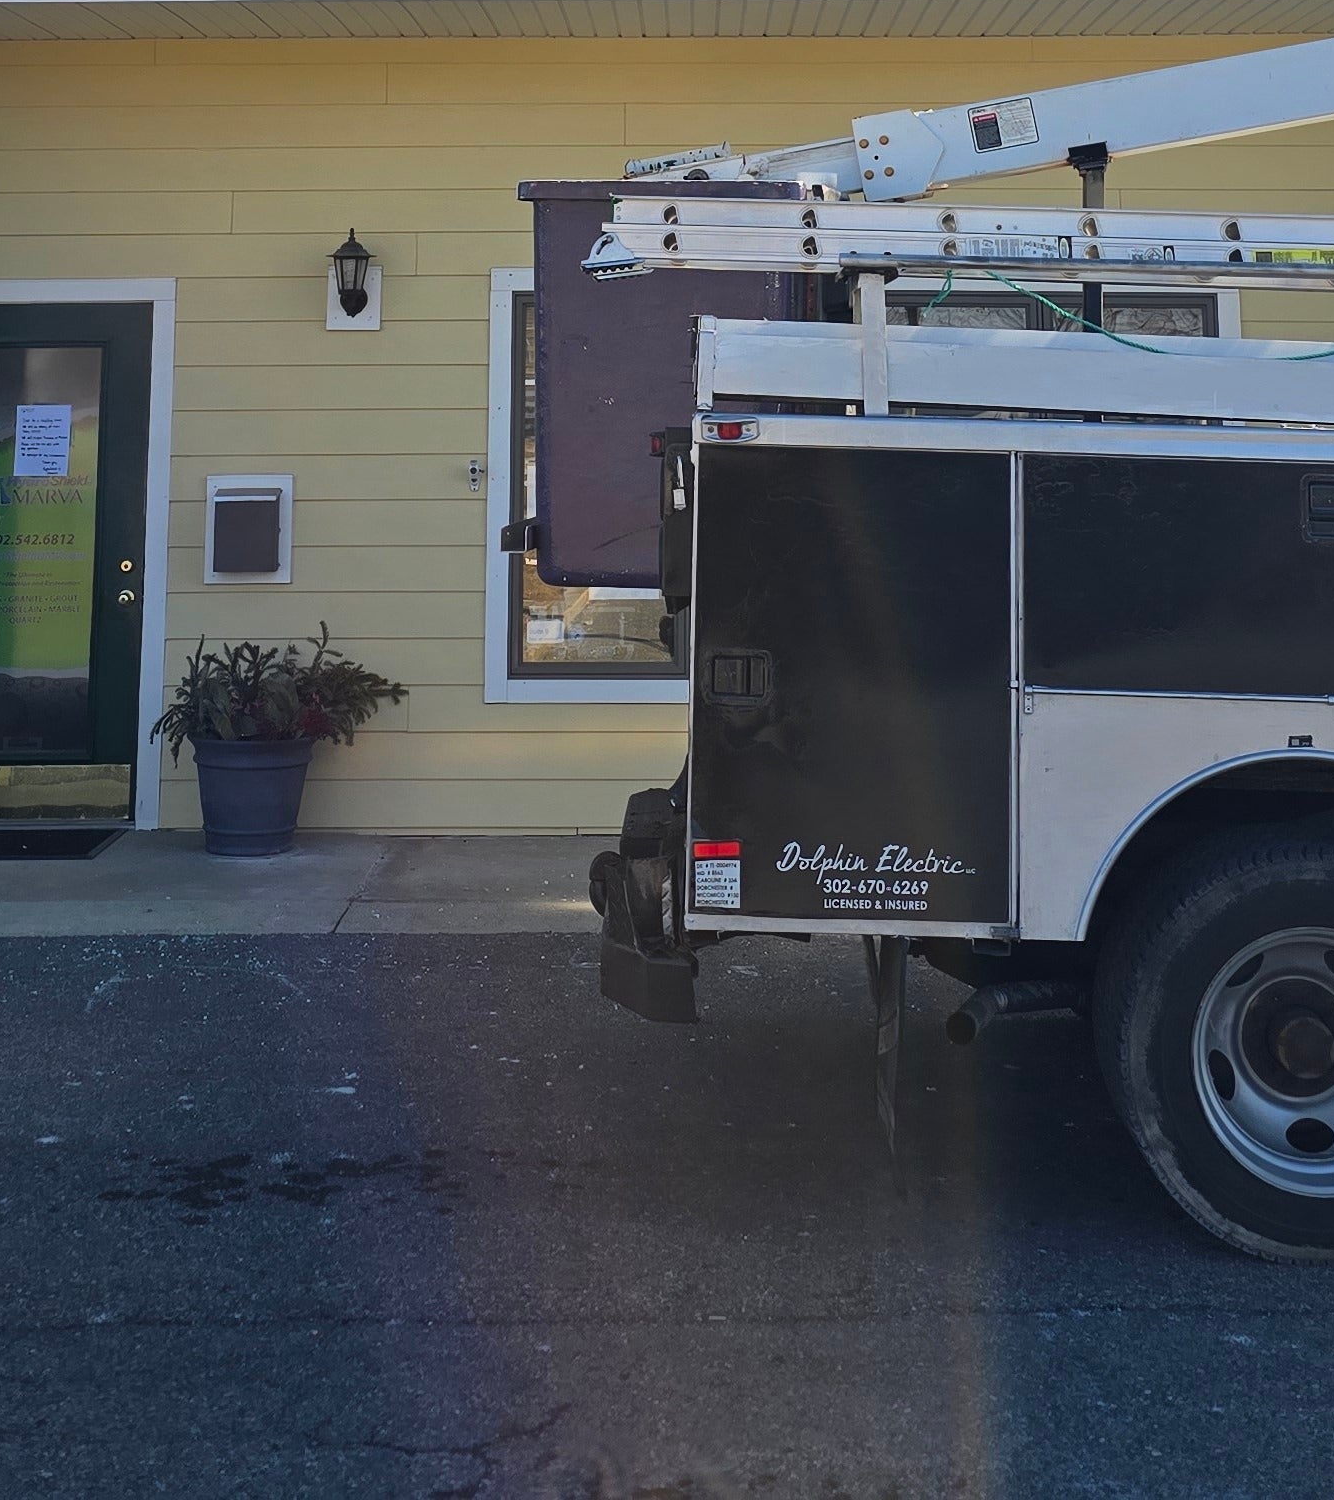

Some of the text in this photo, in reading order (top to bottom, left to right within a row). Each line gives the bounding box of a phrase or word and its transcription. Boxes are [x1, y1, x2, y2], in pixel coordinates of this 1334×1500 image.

[776, 841, 868, 885] Dolphin
[875, 844, 965, 874] Electric
[823, 878, 929, 895] 302-670-6269
[824, 899, 928, 910] LICENSED & INSURED
